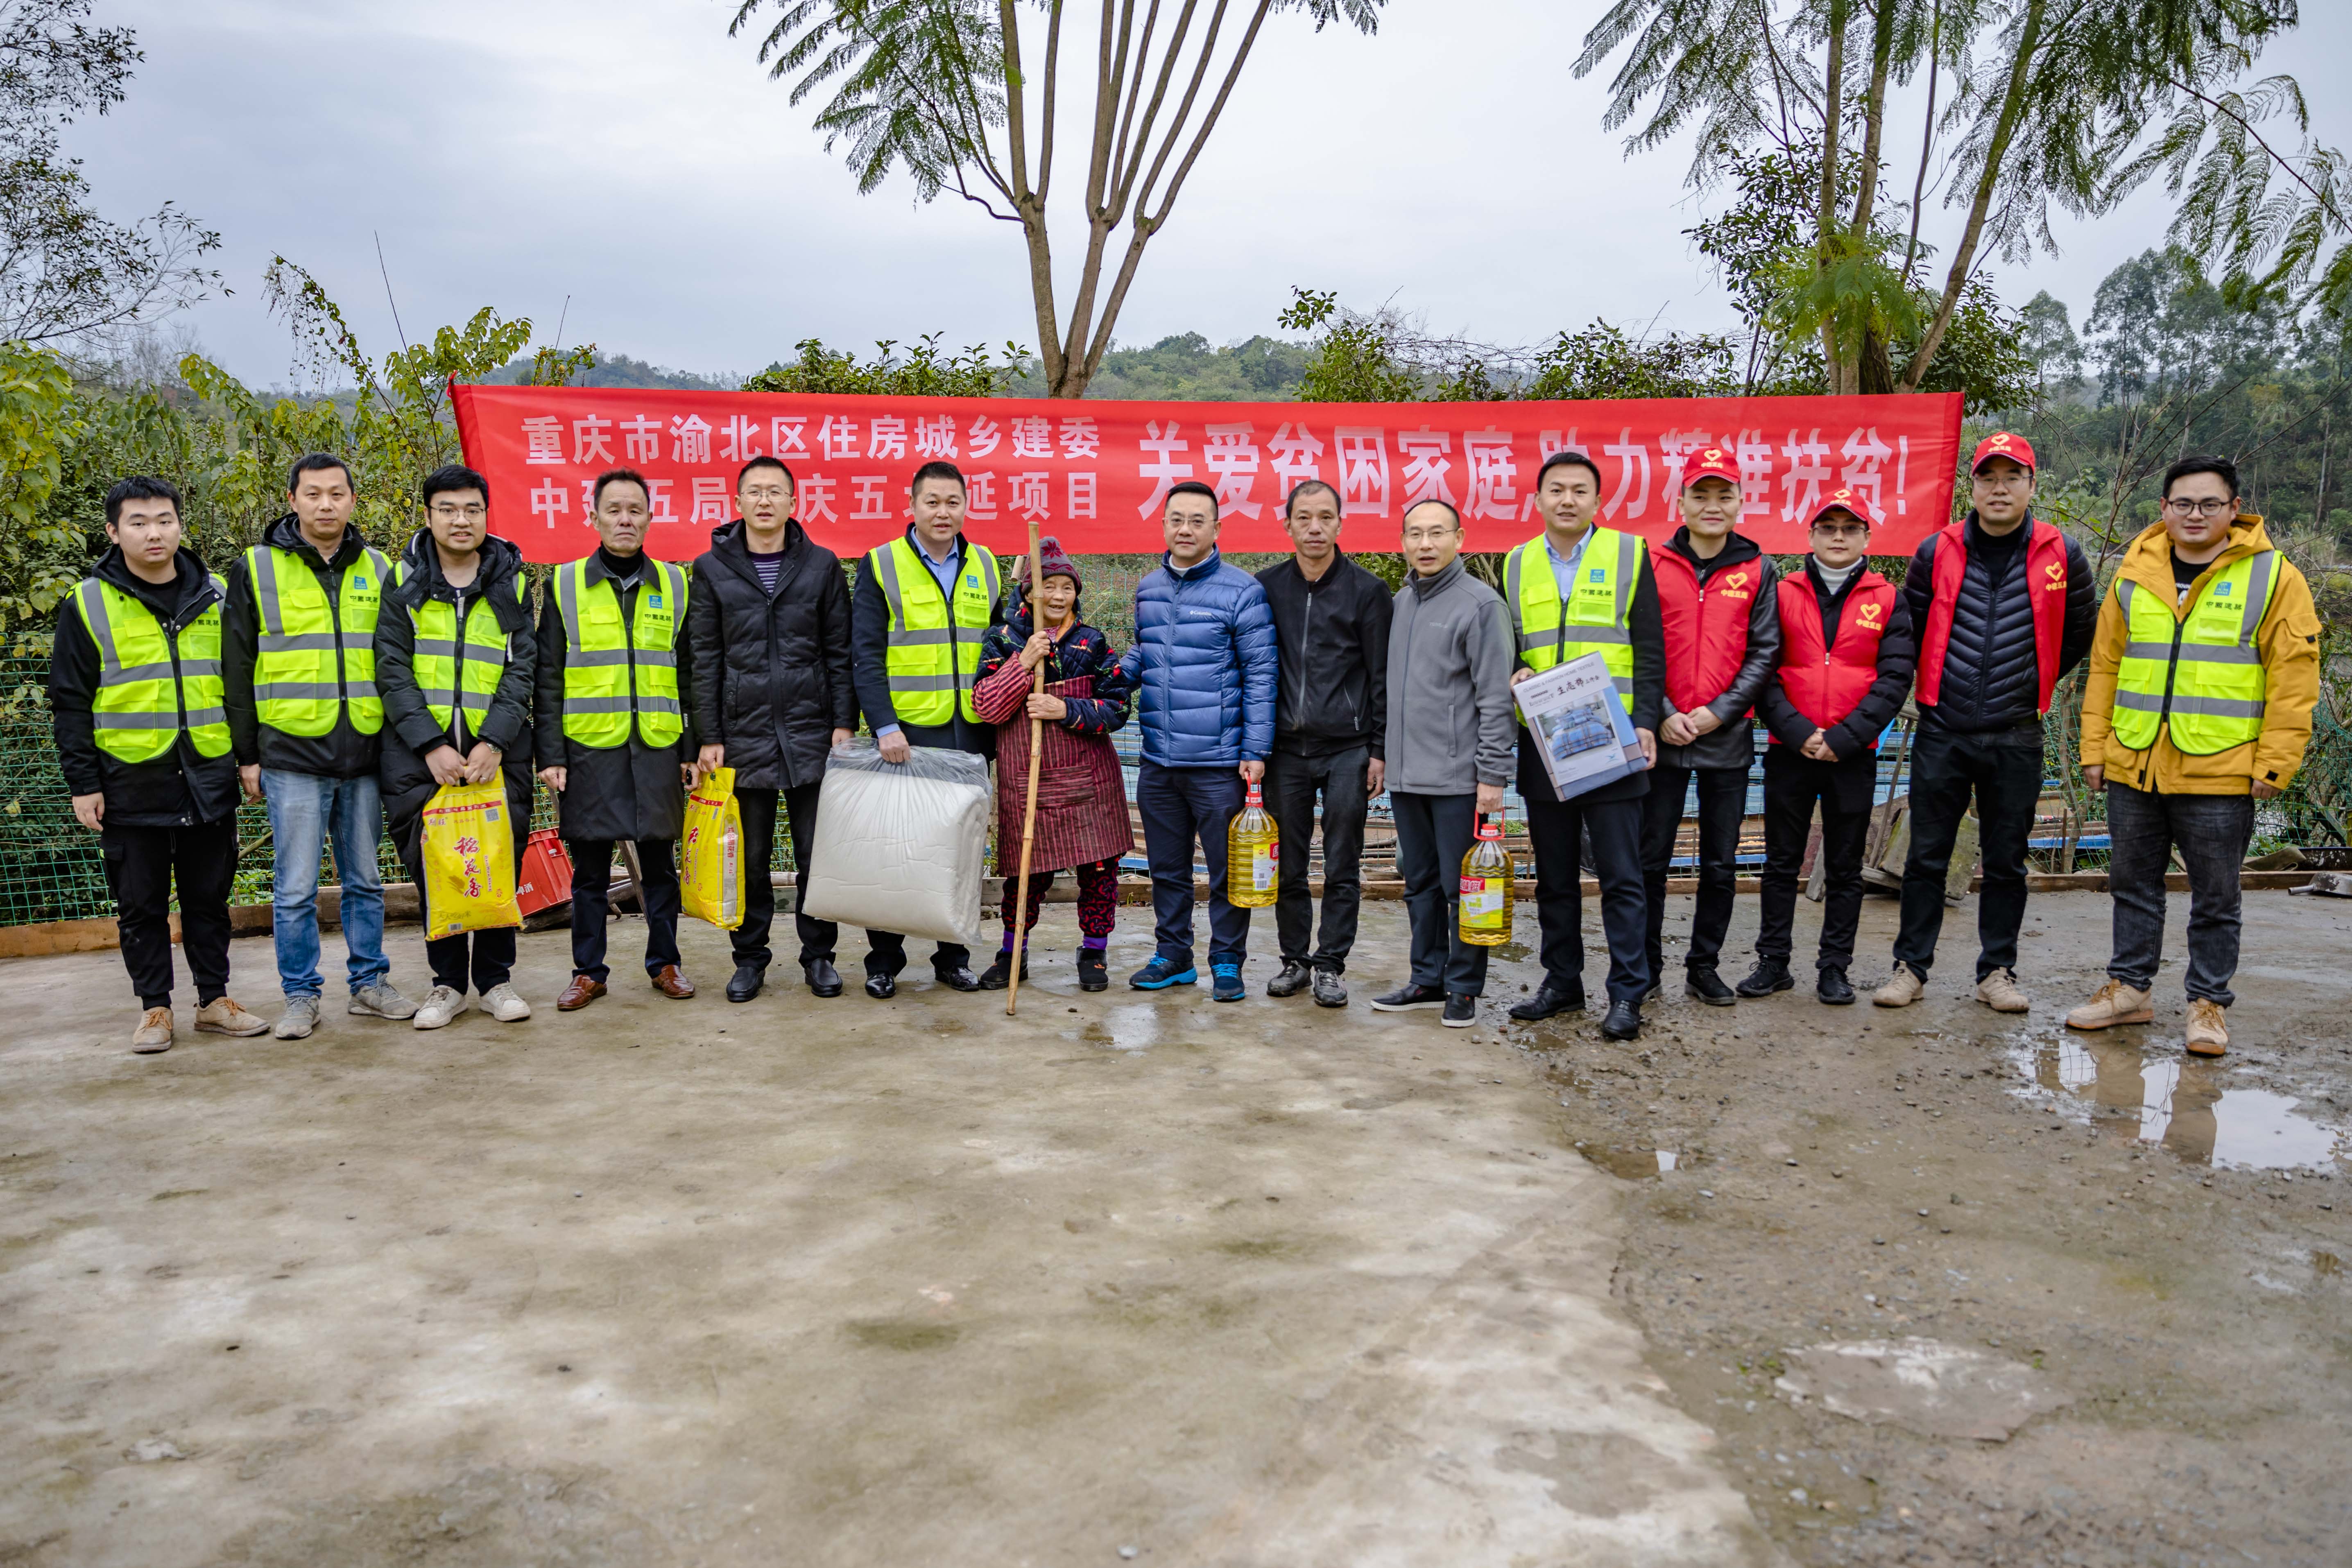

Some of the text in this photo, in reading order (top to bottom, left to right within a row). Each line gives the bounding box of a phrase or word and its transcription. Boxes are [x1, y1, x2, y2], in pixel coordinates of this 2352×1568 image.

[521, 414, 1100, 465] 重庆市渝北区住房城乡建委
[530, 471, 1098, 529] 中五局庆五延项目
[1545, 674, 1564, 685] FASHION
[1578, 662, 1595, 672] TEXTILE
[453, 836, 483, 898] 稻花香
[1460, 878, 1481, 892] 蜻蜓
